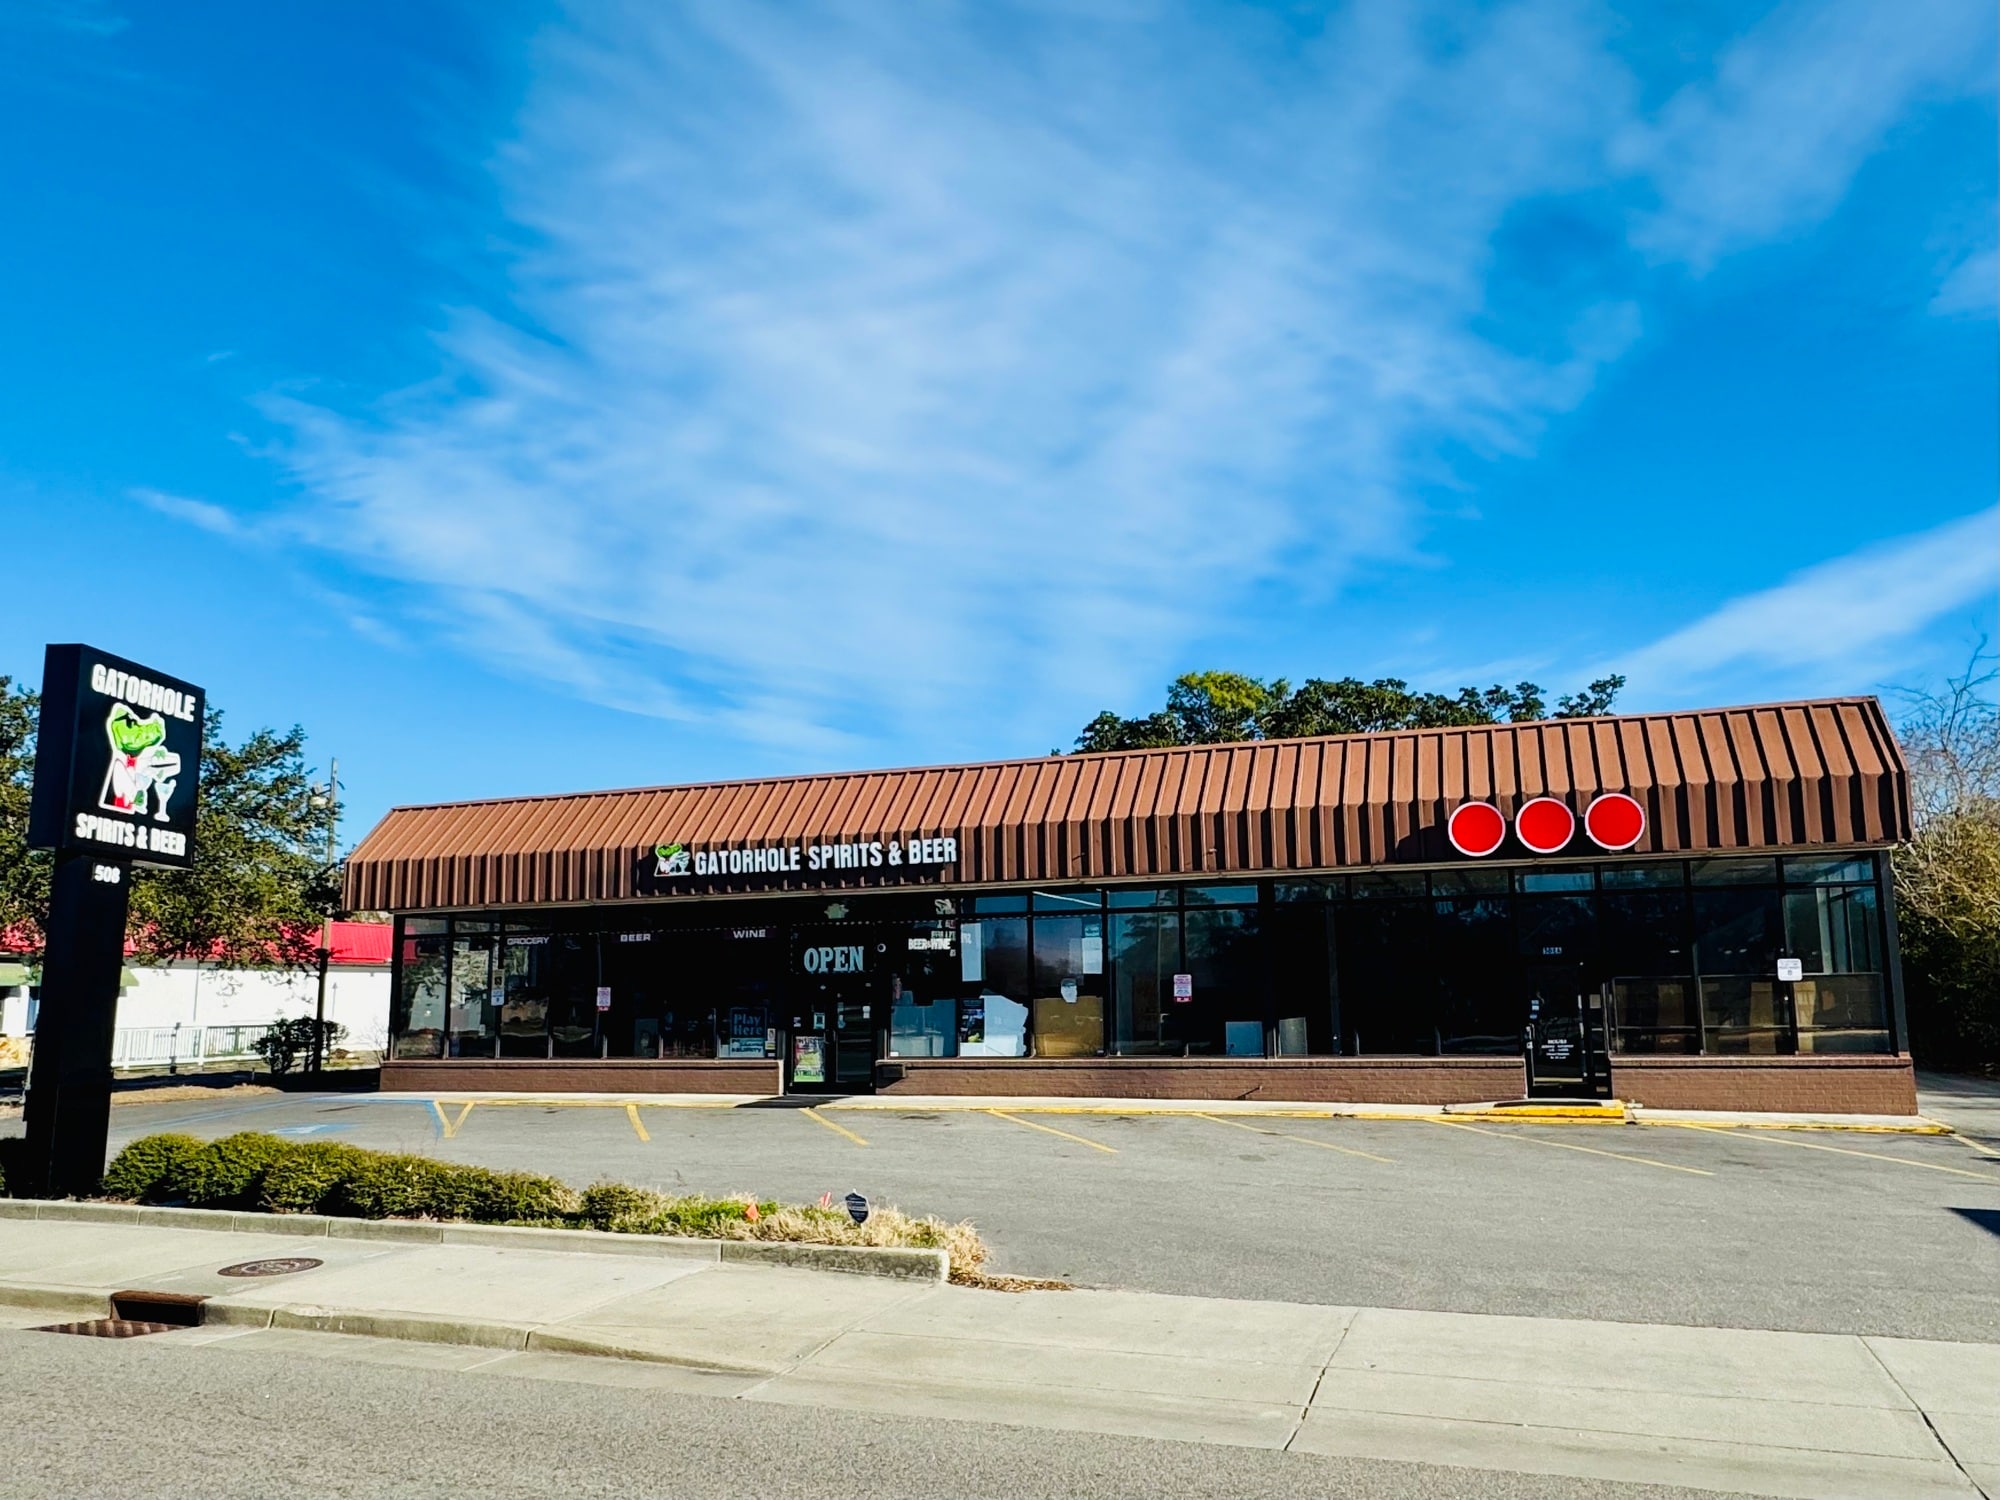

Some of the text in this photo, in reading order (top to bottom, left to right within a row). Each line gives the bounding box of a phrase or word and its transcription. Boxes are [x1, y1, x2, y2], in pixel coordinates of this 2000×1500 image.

[91, 663, 196, 722] GATORHOLE
[75, 812, 186, 857] SPIRITS & BEER
[695, 838, 957, 875] GATORHOLE SPIRITS & BEER
[94, 864, 121, 884] 508
[507, 936, 550, 946] GROCERY
[620, 933, 651, 943] BEER
[733, 929, 767, 939] WINE
[803, 946, 864, 973] OPEN
[734, 1013, 762, 1027] Play
[734, 1025, 764, 1036] Here
